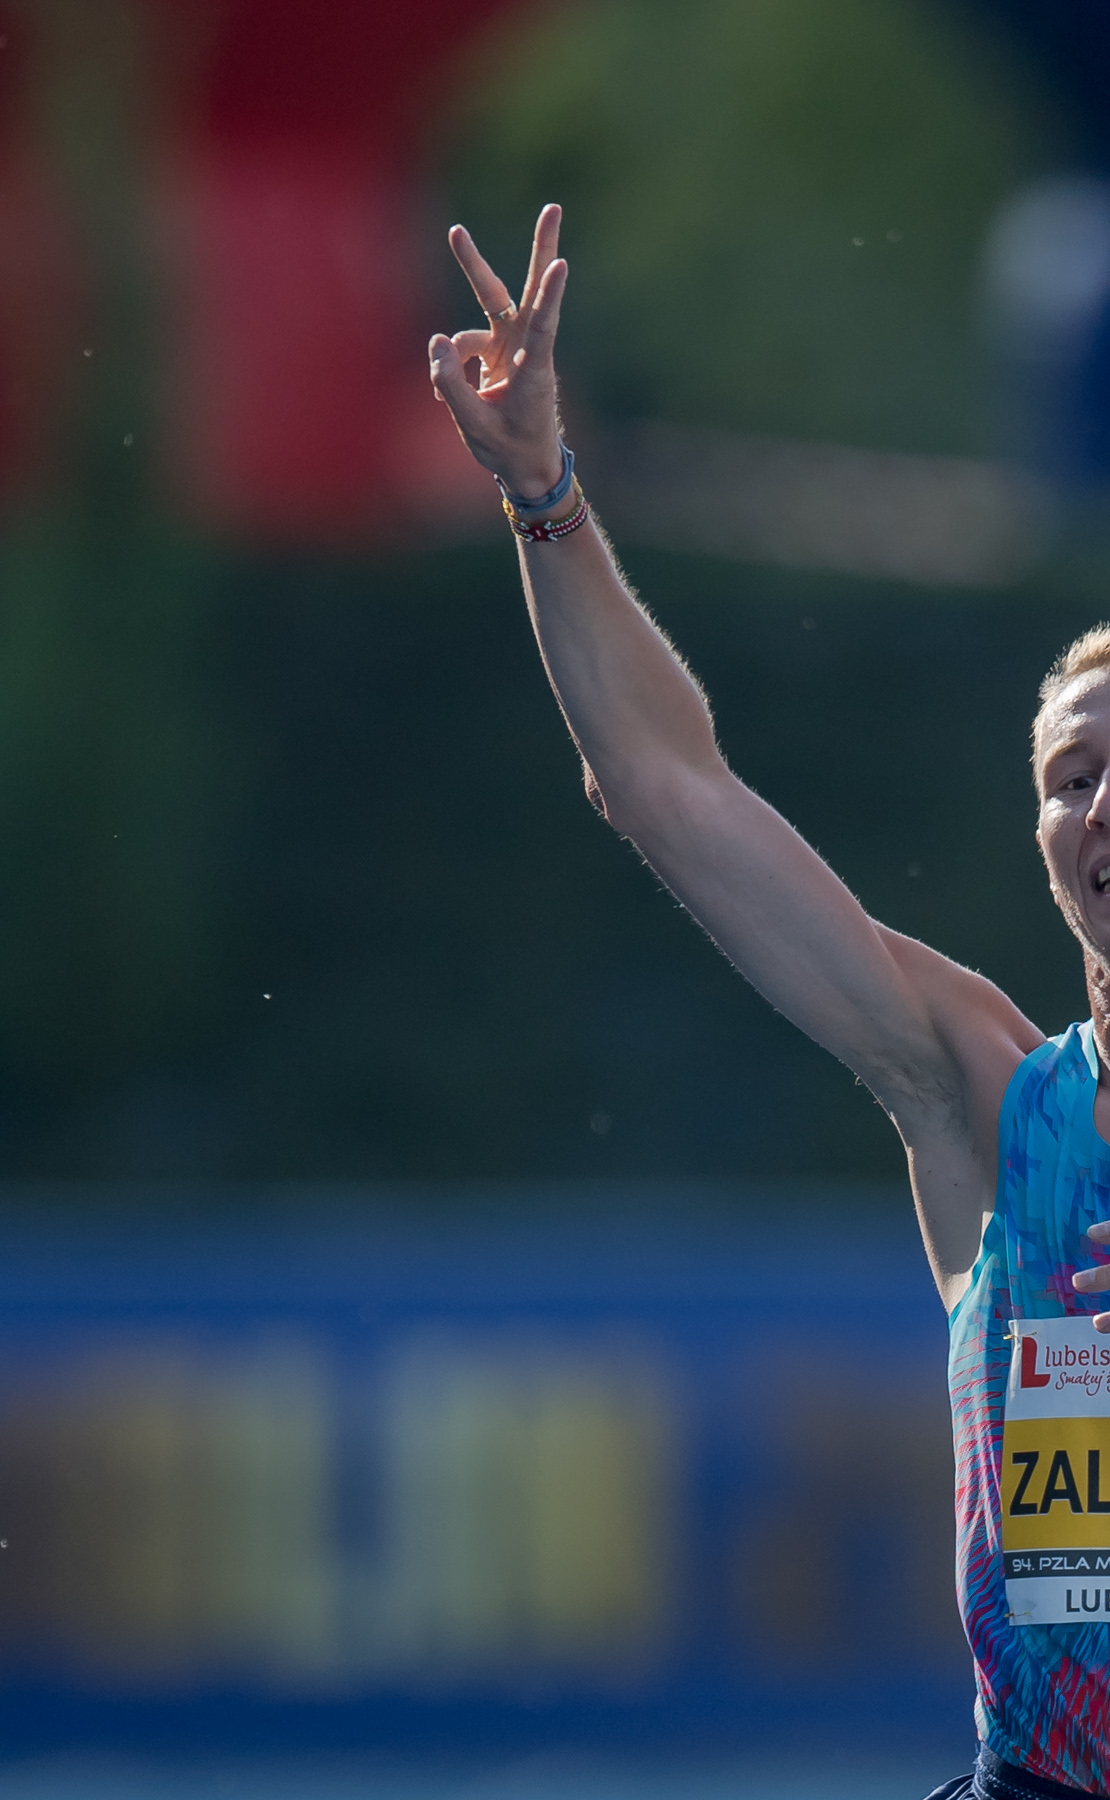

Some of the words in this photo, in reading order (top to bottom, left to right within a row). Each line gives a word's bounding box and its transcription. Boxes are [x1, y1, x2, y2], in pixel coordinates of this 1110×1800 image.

[1055, 1369, 1105, 1396] Smakuj
[1012, 1557, 1035, 1572] 94.
[1039, 1556, 1090, 1571] PZLA
